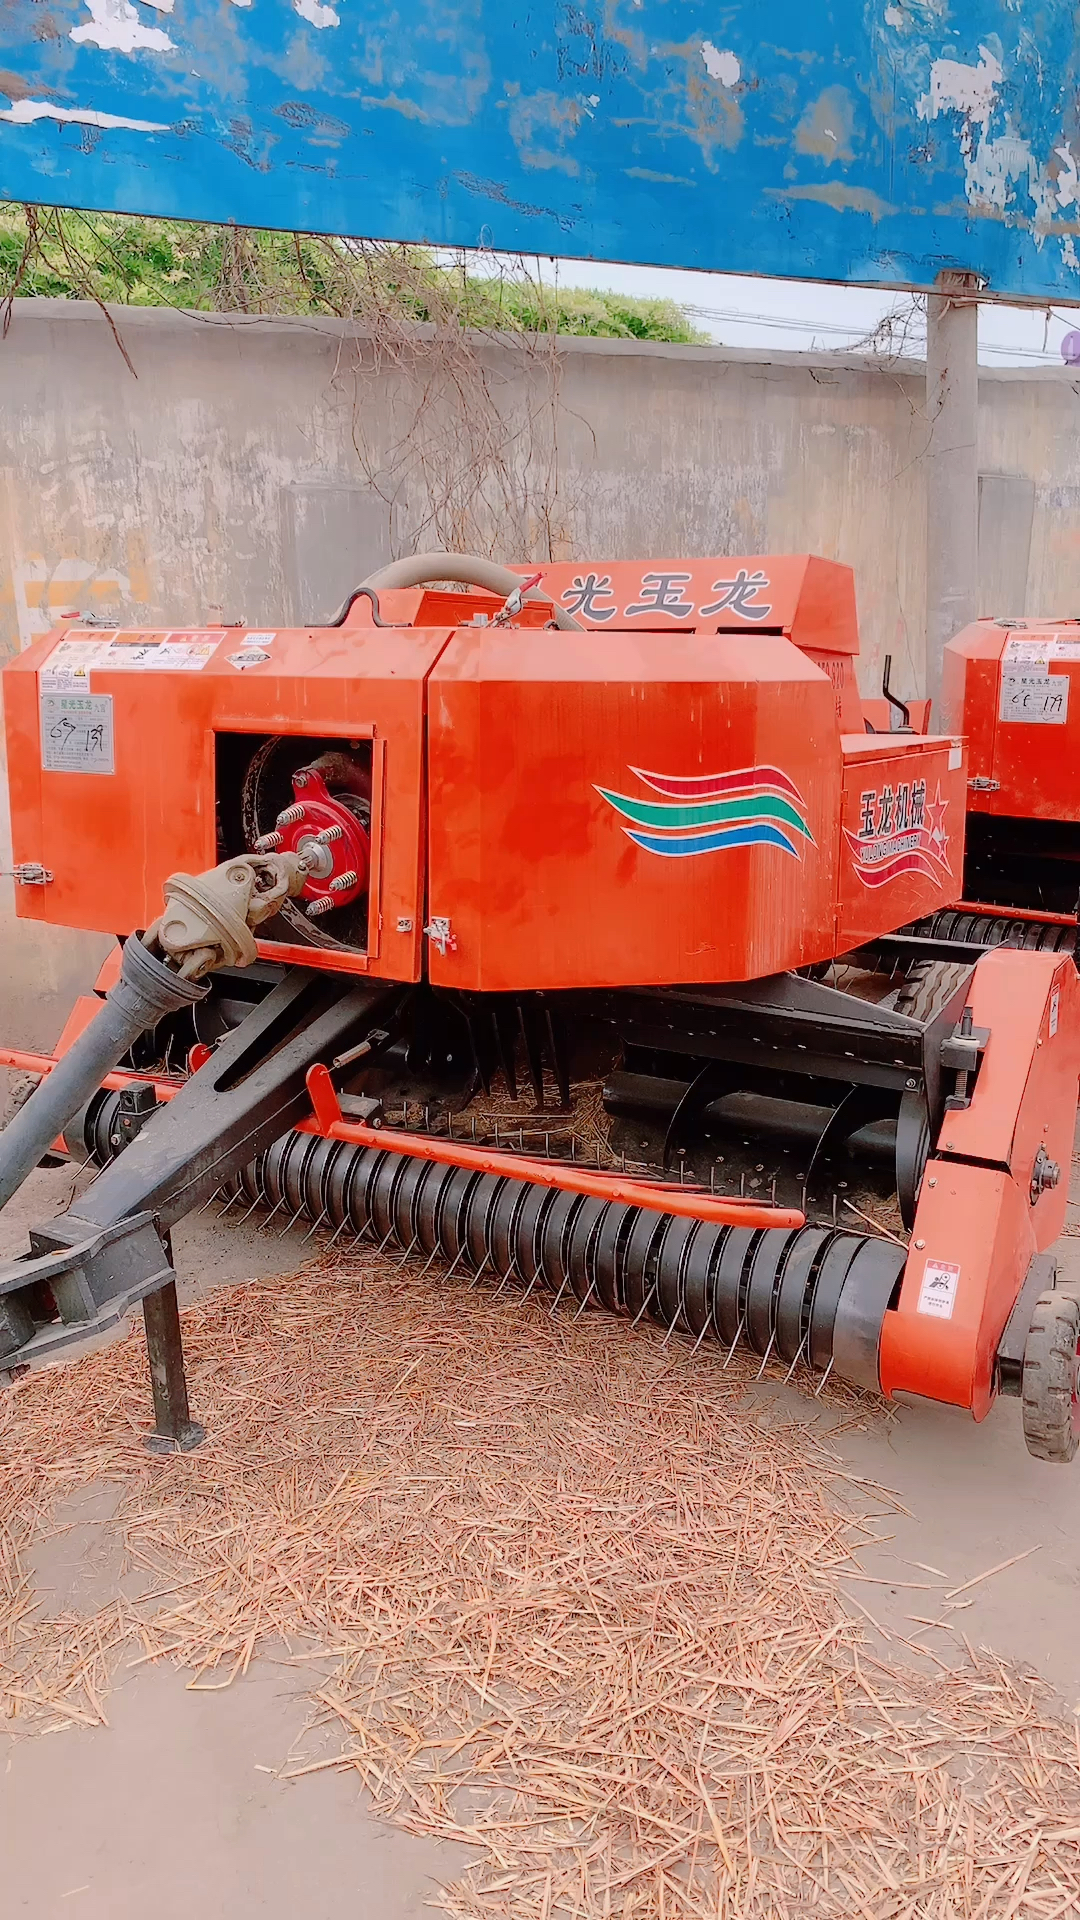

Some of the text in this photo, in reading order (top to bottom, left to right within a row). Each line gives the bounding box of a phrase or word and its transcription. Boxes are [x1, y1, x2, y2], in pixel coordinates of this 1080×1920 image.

[518, 567, 773, 624] 光玉龙
[857, 779, 926, 839] 玉龙机械
